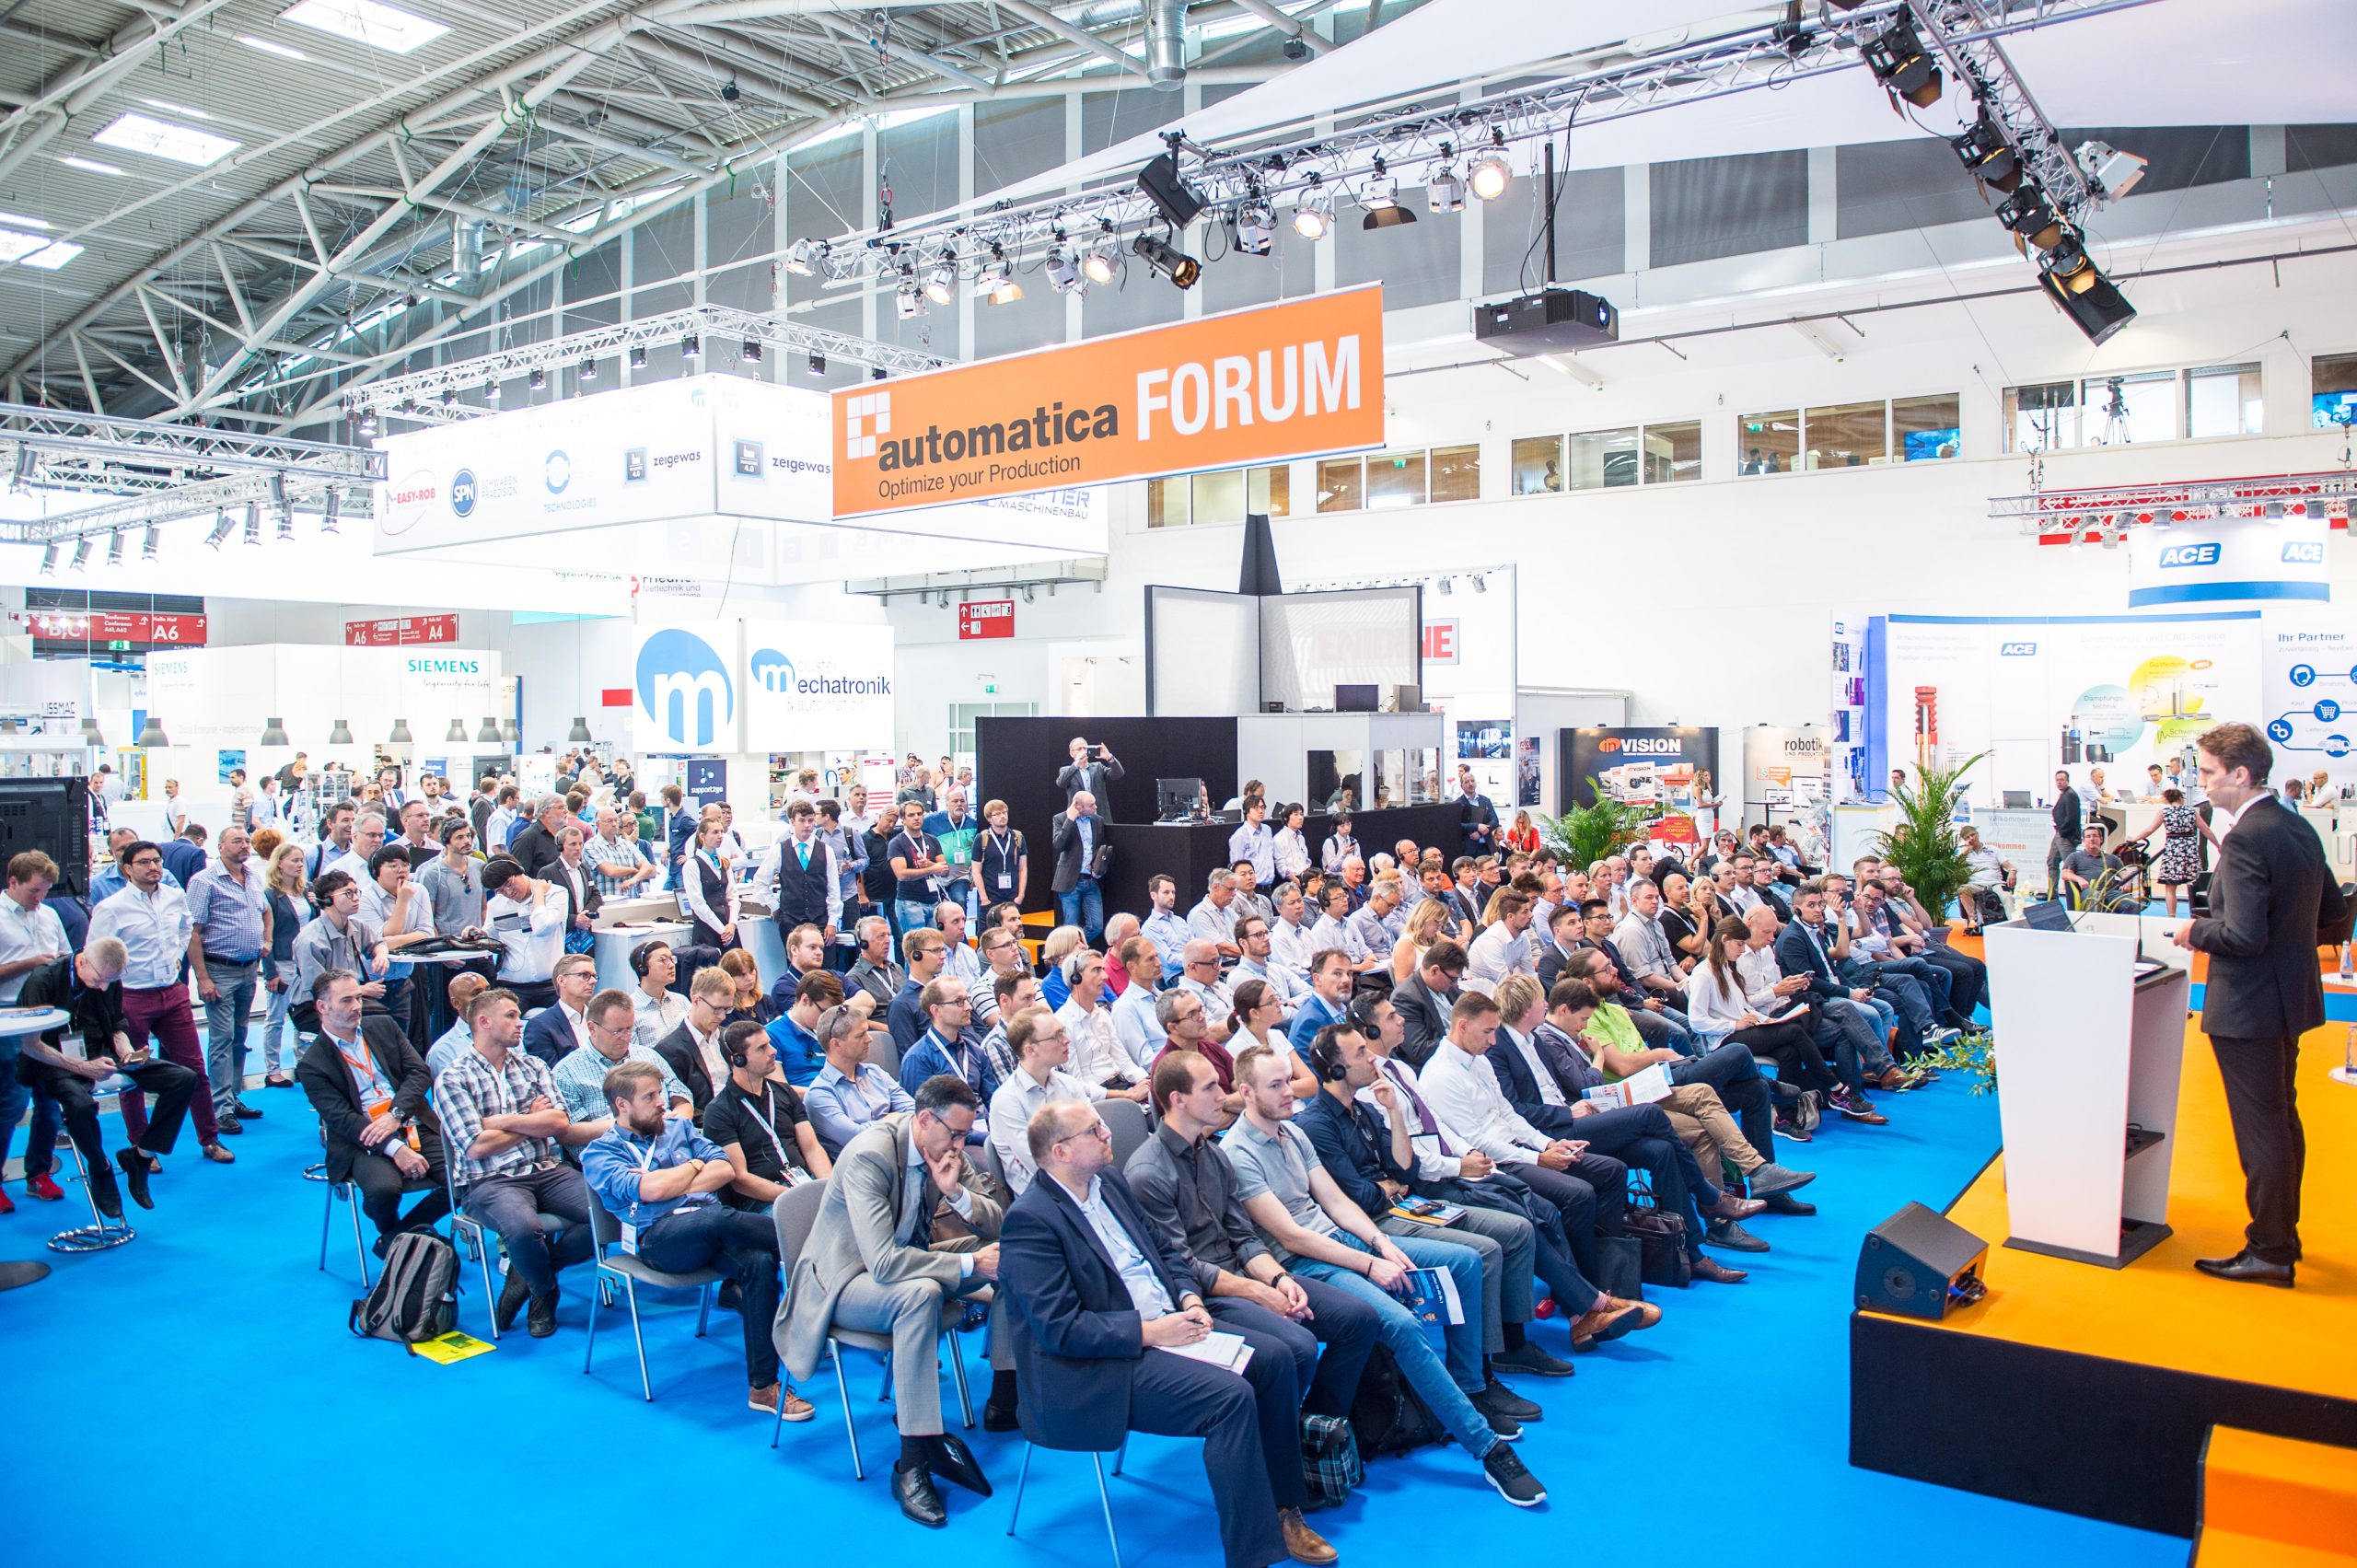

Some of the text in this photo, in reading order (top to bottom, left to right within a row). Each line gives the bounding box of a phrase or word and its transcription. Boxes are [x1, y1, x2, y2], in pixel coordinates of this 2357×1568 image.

[878, 334, 1362, 471] automatica FORUM
[878, 449, 1081, 501] Optimize your Production
[453, 482, 475, 504] SPN
[544, 497, 598, 514] TECHNOLOGIES
[998, 500, 1089, 520] MASCHINENBAU
[2161, 545, 2215, 566] ACE
[2284, 544, 2323, 562] ACE
[685, 584, 701, 592] und
[152, 626, 180, 641] A6
[354, 631, 367, 645] A6
[428, 625, 444, 641] A4
[2278, 633, 2346, 643] Ihr Partner
[2003, 644, 2036, 655] ACE
[154, 662, 189, 675] SIEMENS
[408, 659, 479, 673] SIEMENS
[1784, 737, 1824, 750] robotik
[691, 785, 724, 795] support2go
